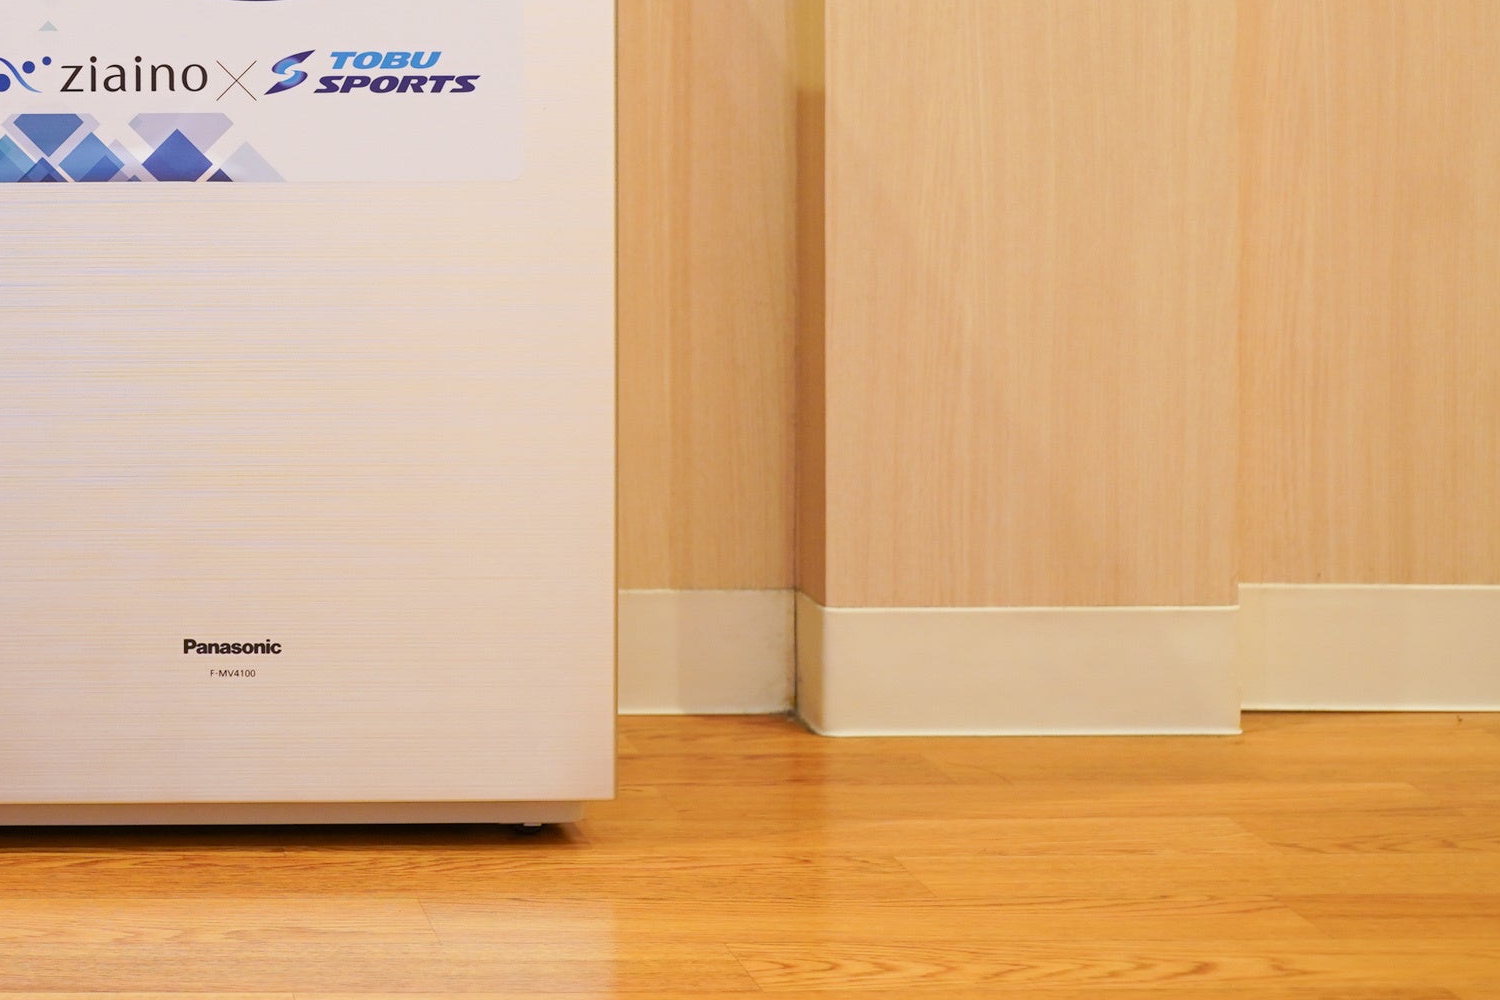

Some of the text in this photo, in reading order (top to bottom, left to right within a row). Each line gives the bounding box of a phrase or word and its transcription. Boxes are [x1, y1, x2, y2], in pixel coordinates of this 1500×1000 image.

[329, 51, 442, 70] TOBU
[59, 55, 208, 93] ziaino
[313, 75, 482, 94] SPORTS
[183, 638, 282, 654] Panasonic
[210, 669, 256, 678] F-MV4100
